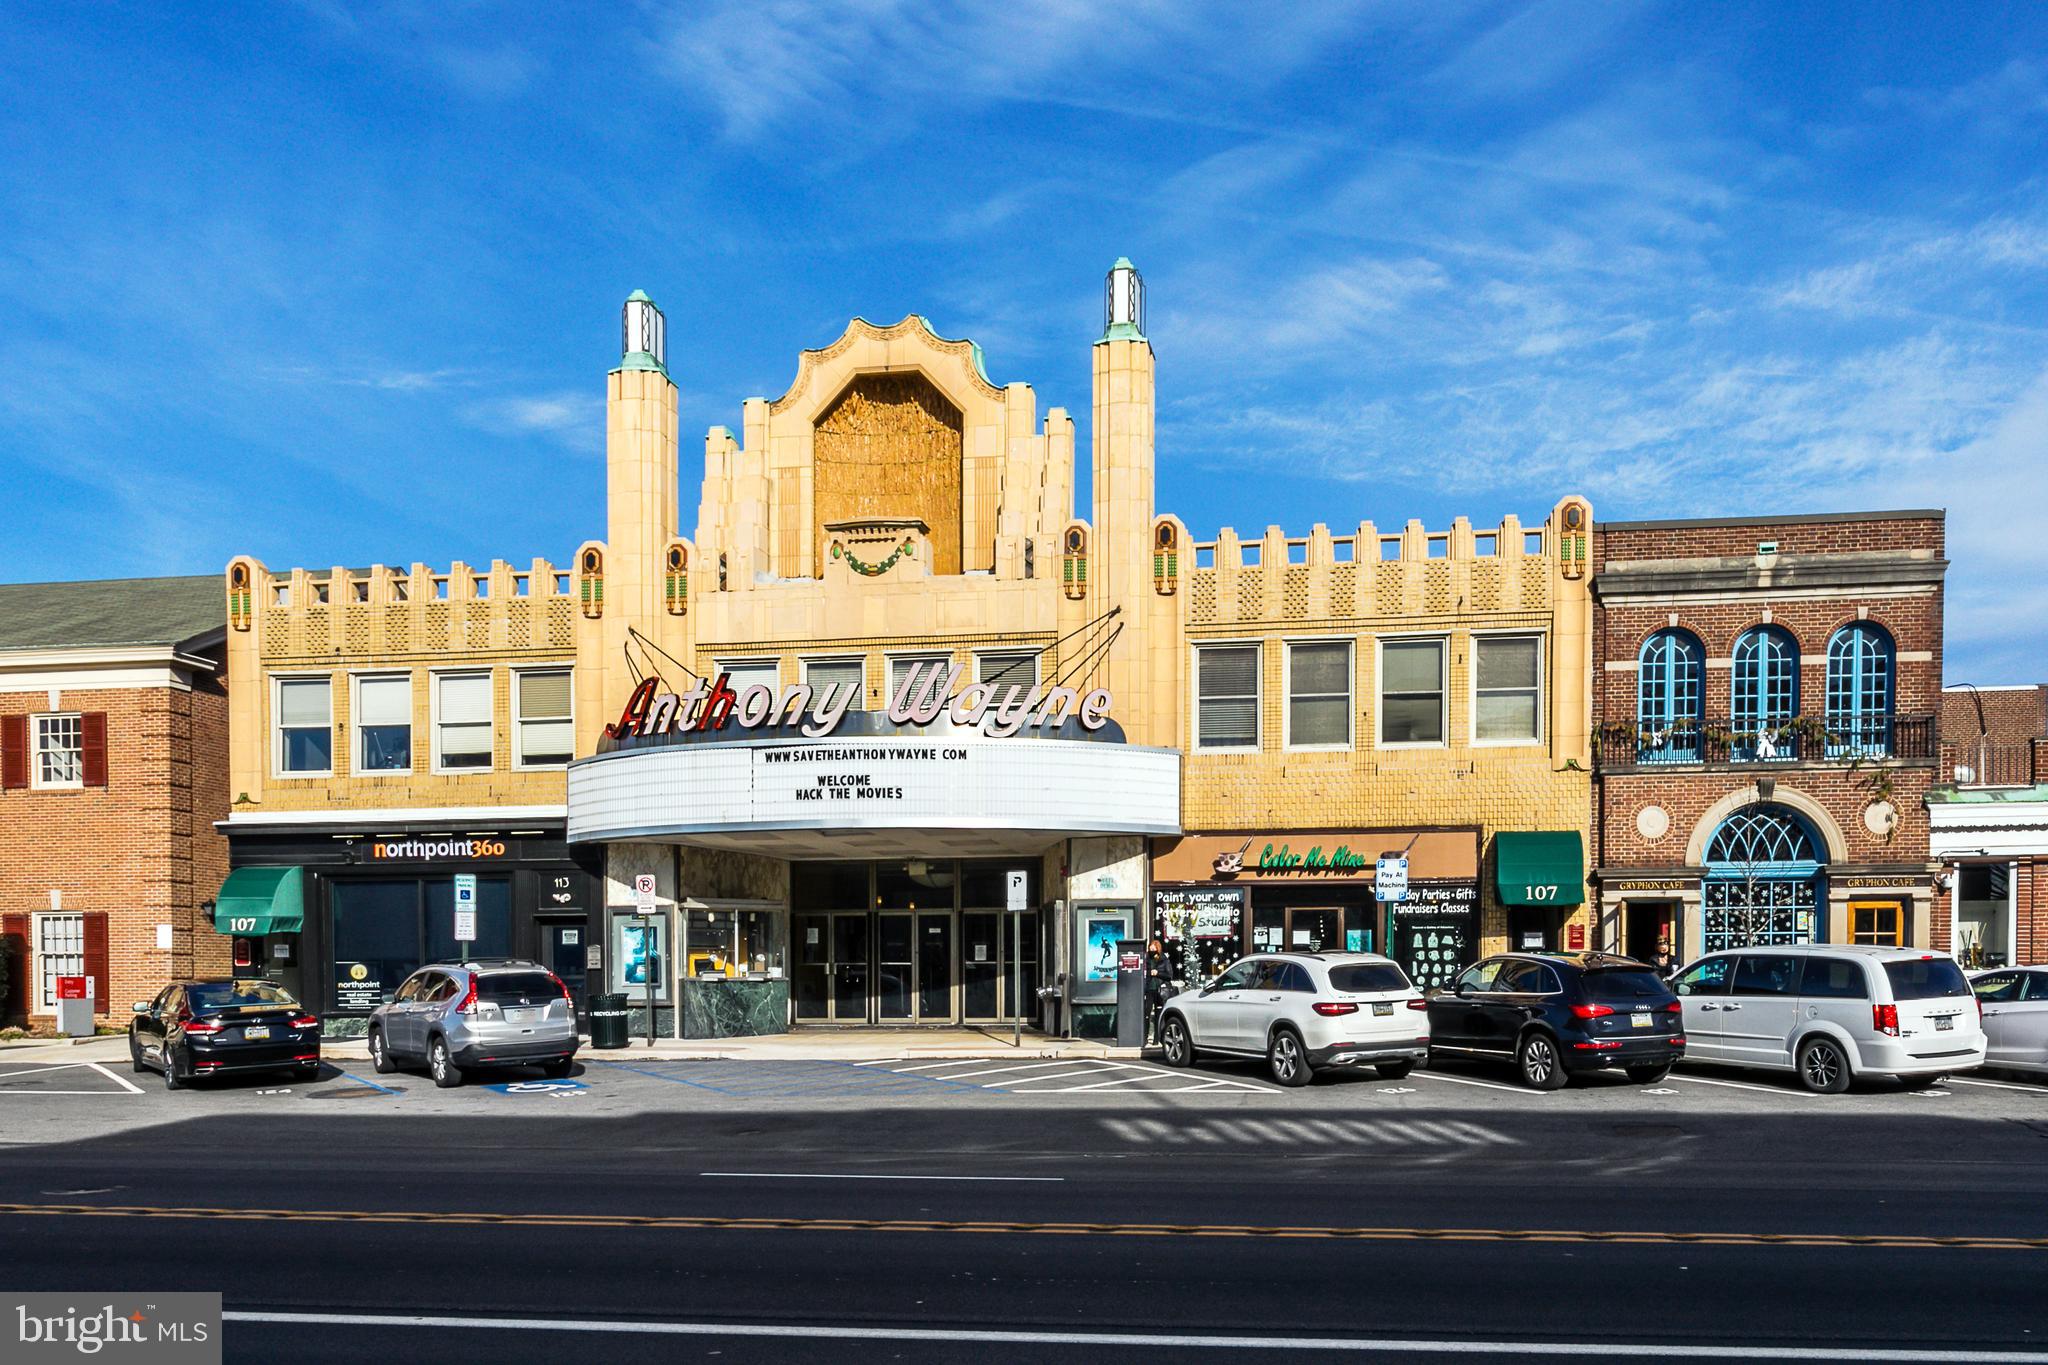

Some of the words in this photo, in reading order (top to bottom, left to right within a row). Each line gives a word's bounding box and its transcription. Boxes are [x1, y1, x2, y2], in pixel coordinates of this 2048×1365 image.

[606, 673, 860, 739] Anthony
[888, 662, 1114, 738] Wayne
[765, 752, 791, 763] WWW
[942, 749, 967, 760] COM
[817, 774, 871, 787] WELCOME
[796, 789, 823, 801] HACK
[829, 788, 850, 800] THE
[857, 787, 903, 799] MOVIES
[374, 839, 505, 861] northpoint360
[1261, 843, 1302, 869] Color
[1304, 846, 1328, 868] Me
[1330, 845, 1367, 868] Mine
[554, 877, 570, 888] 113
[1620, 881, 1661, 890] GRYPHON
[1662, 881, 1685, 889] CAFE
[1847, 878, 1890, 887] GRYPHON
[1892, 878, 1916, 886] CAFE
[1156, 891, 1185, 903] Paint
[1189, 893, 1214, 905] your
[1218, 893, 1240, 902] own
[1422, 889, 1450, 900] Parties
[1456, 888, 1477, 900] Gifts
[1525, 885, 1558, 901] 107
[1156, 906, 1198, 920] Pottery
[1204, 905, 1240, 917] Studio
[1393, 902, 1439, 914] Fundraisers
[1441, 901, 1470, 913] Classes
[230, 917, 257, 932] 107
[338, 981, 380, 989] northpoint
